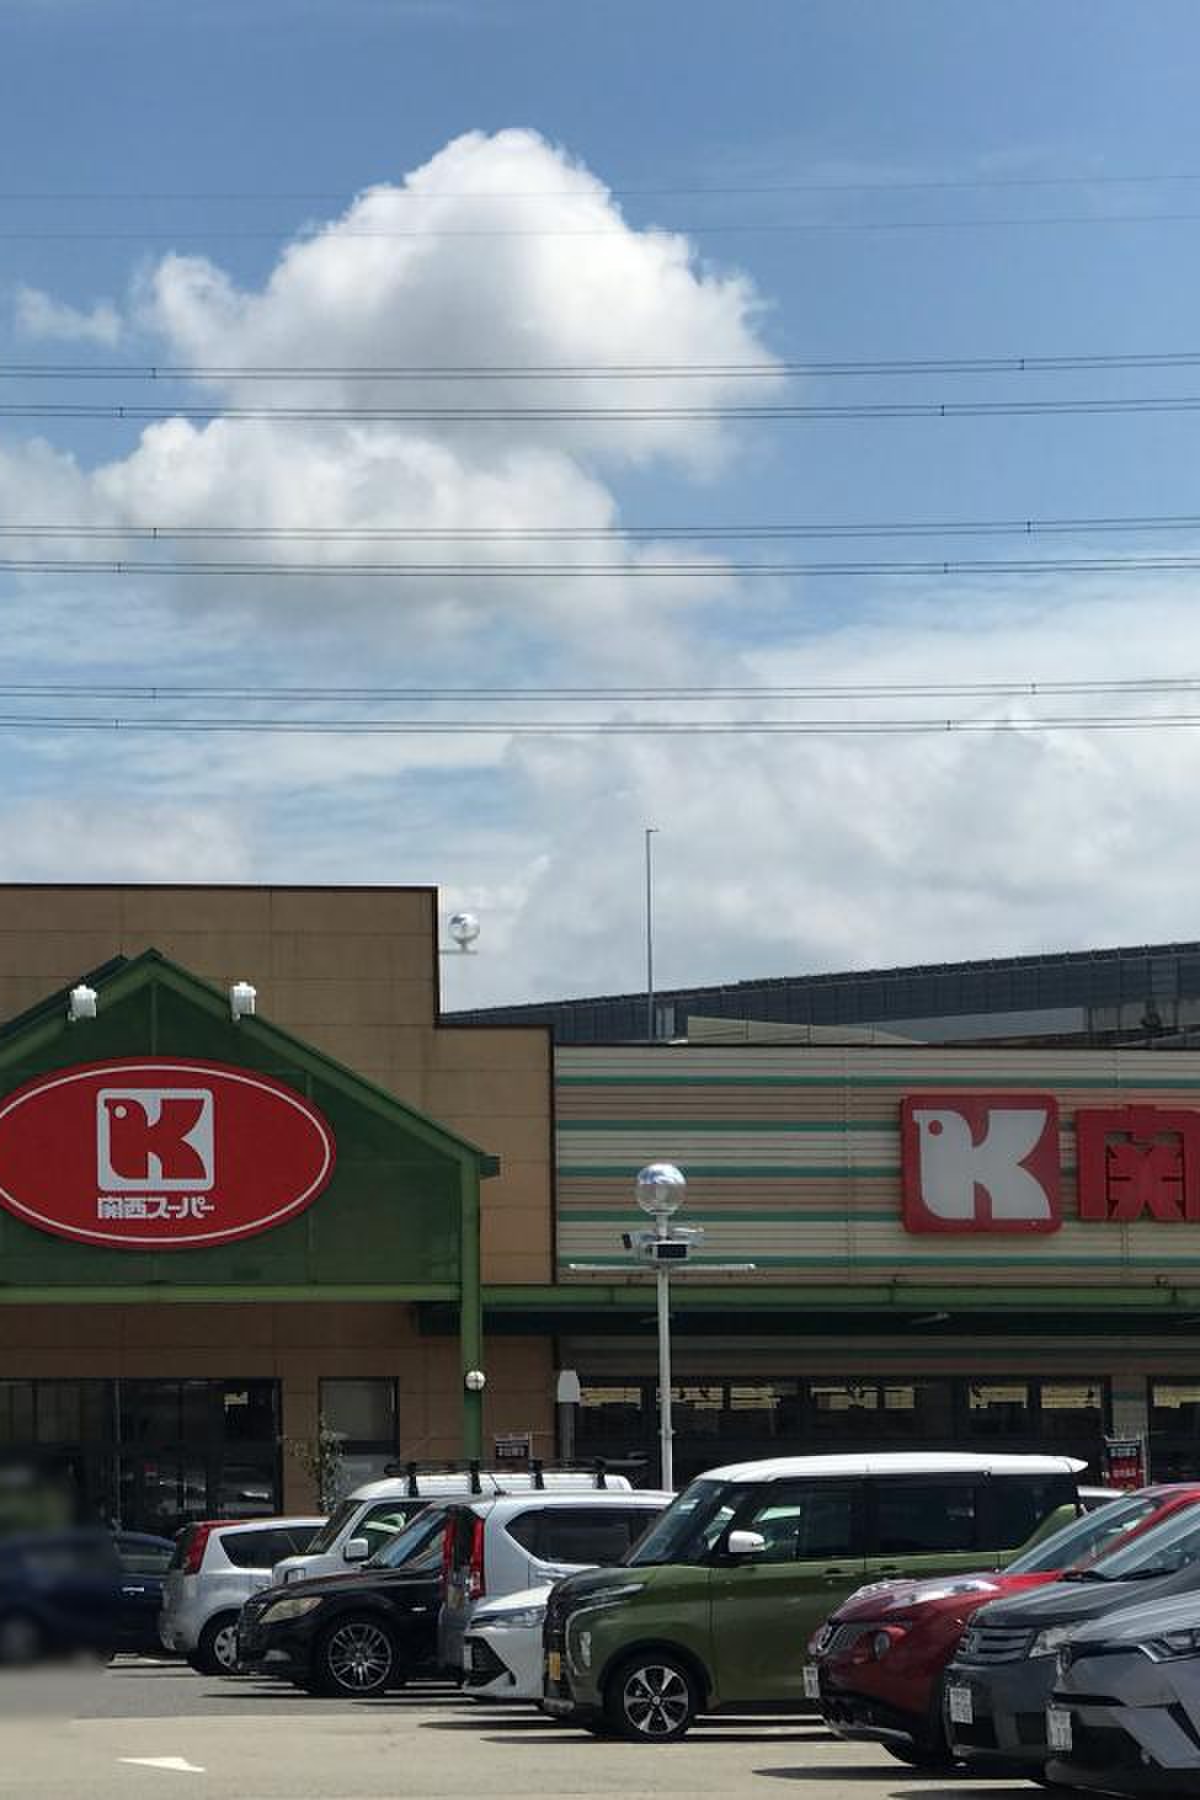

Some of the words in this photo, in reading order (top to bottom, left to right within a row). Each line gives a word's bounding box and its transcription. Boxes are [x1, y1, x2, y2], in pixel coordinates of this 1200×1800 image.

[97, 1196, 215, 1219] 関西スーパー
